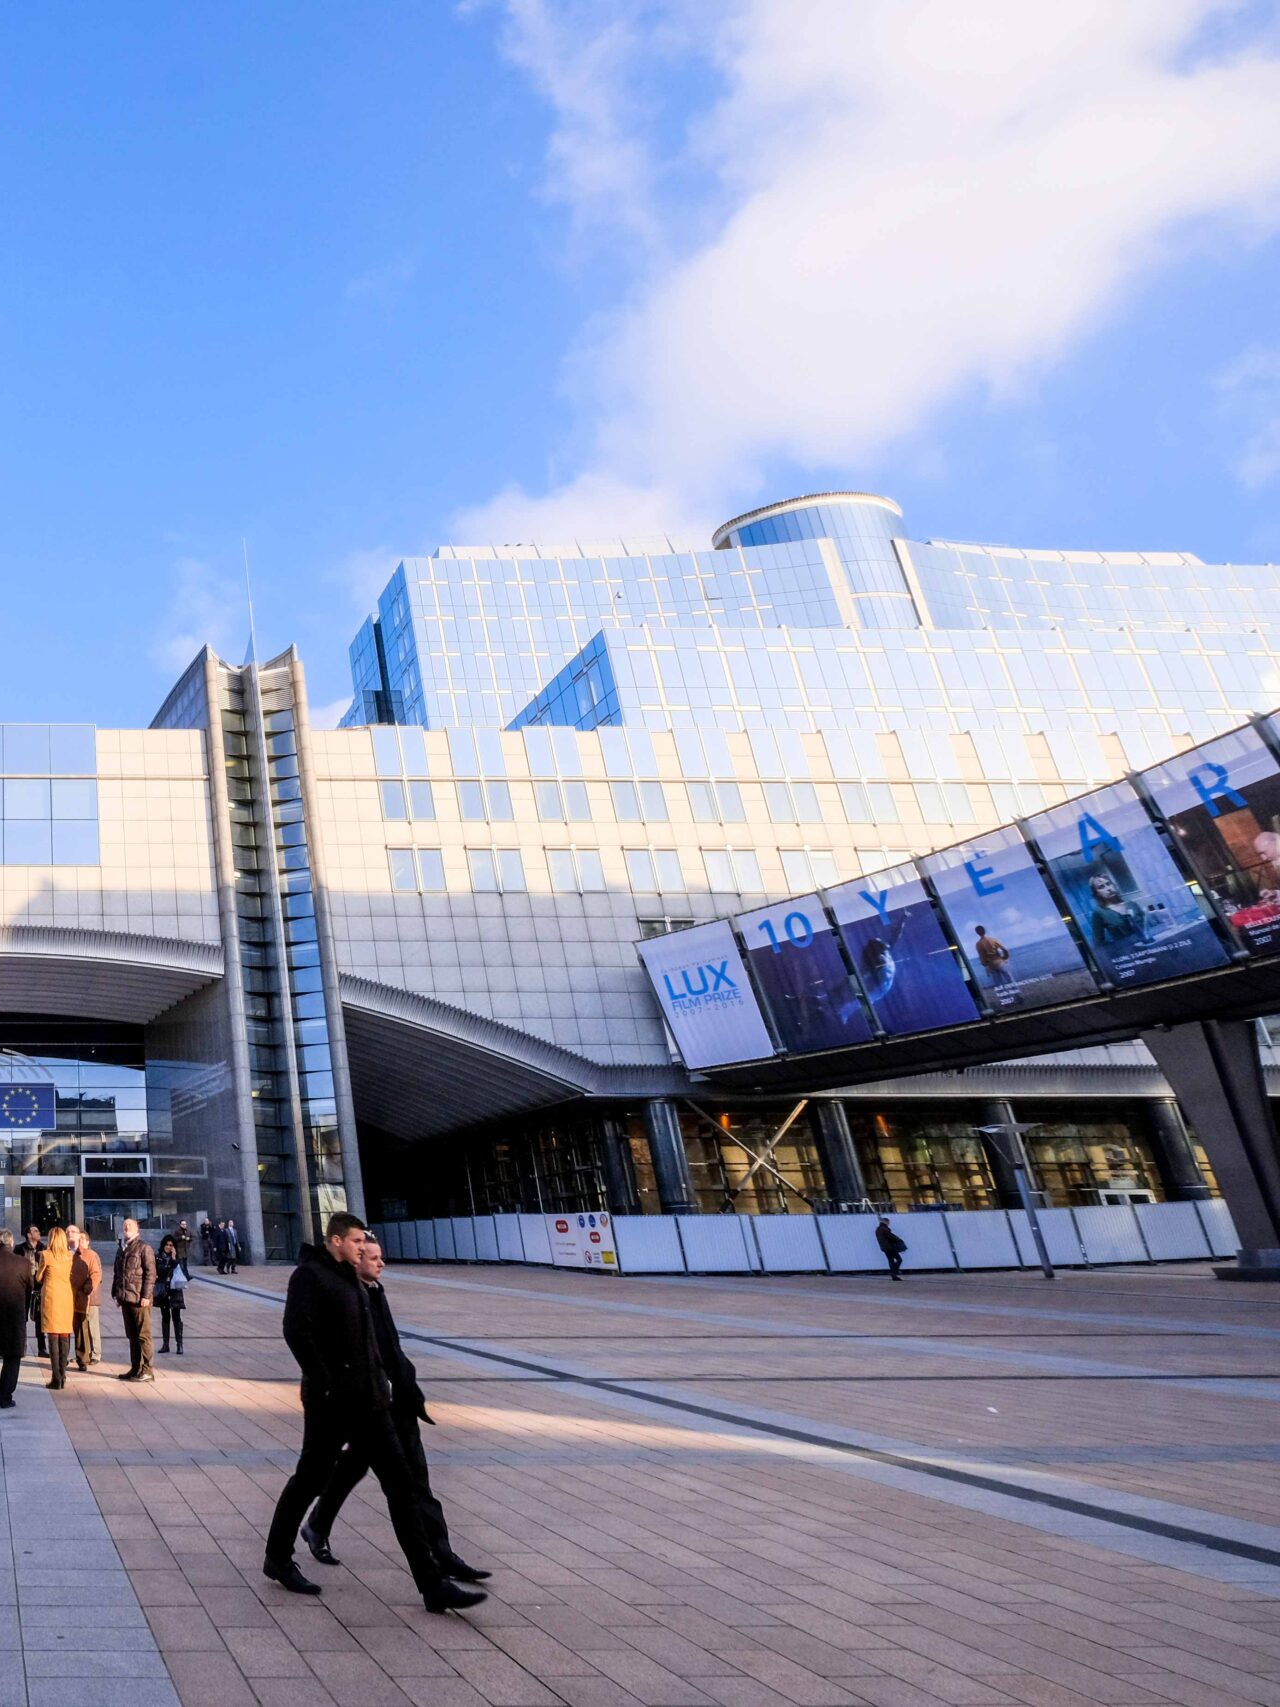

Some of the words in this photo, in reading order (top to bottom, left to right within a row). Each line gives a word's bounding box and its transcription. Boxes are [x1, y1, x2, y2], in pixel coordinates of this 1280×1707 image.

[1186, 762, 1249, 818] R
[1077, 812, 1125, 864] A
[963, 850, 1005, 897] E
[857, 889, 891, 927] Y
[758, 911, 814, 954] 10
[1253, 934, 1273, 946] 2007
[663, 960, 737, 1000] LUX
[672, 997, 702, 1011] FILM
[703, 988, 742, 1004] PRIZE
